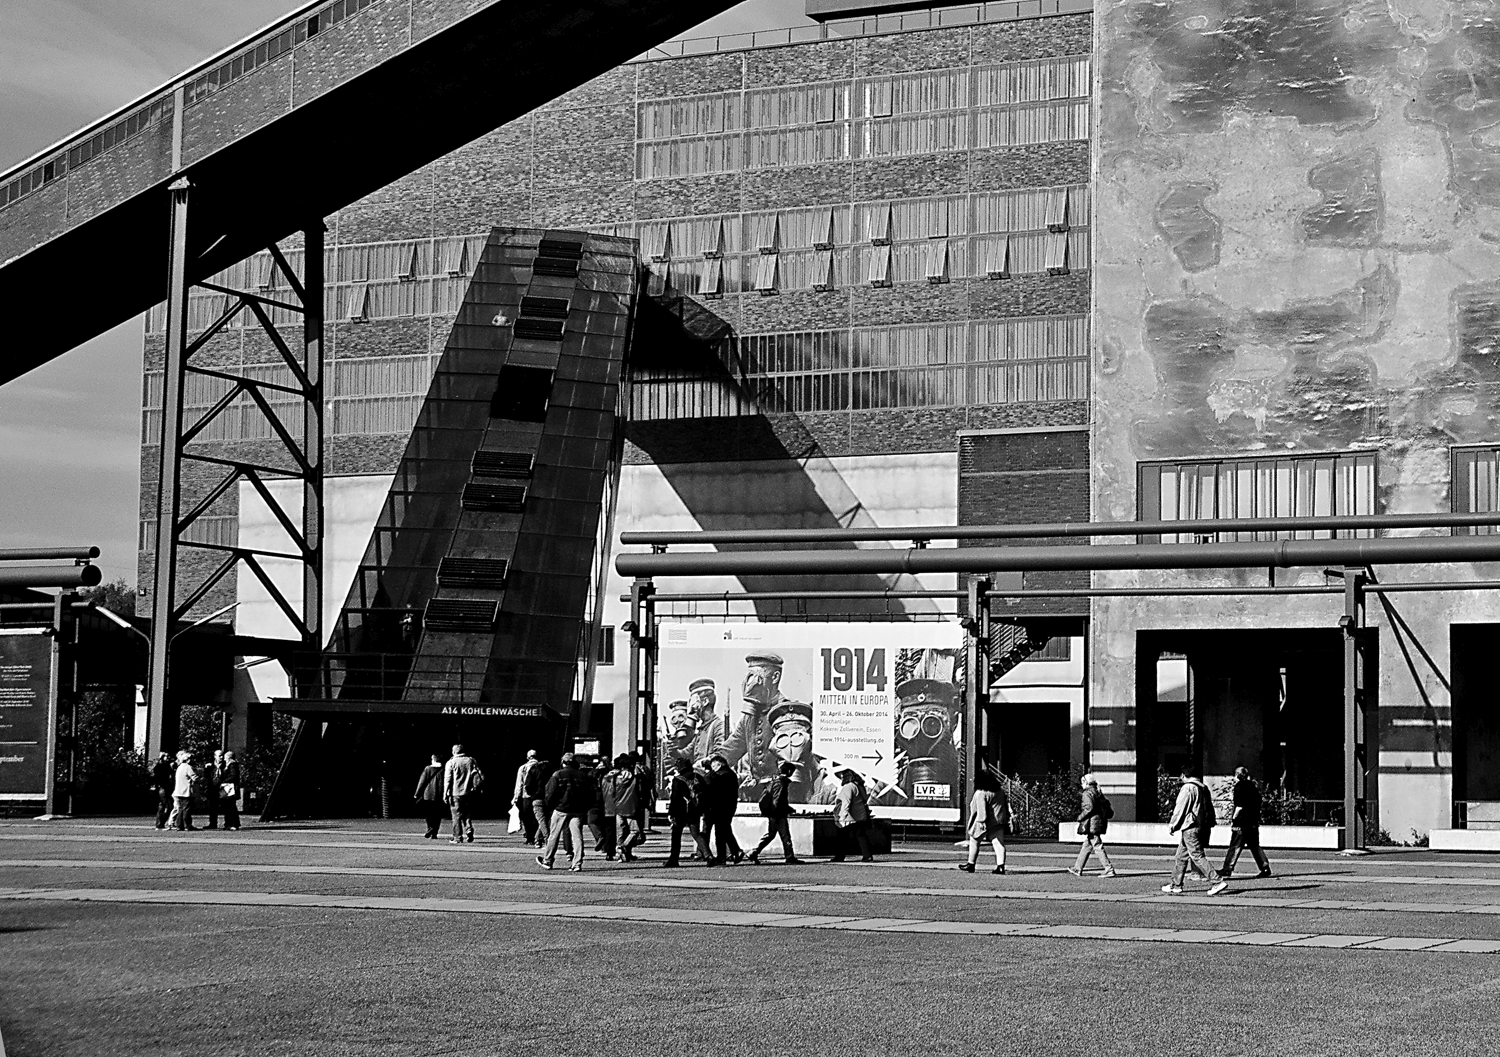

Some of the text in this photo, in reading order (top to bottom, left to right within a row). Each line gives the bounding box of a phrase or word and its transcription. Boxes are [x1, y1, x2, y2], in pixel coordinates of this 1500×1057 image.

[821, 648, 887, 691] 1914
[819, 695, 889, 705] MITTEN IN EUROPA
[461, 707, 538, 716] KOHLENWÄSCHE
[916, 786, 936, 794] LVR
